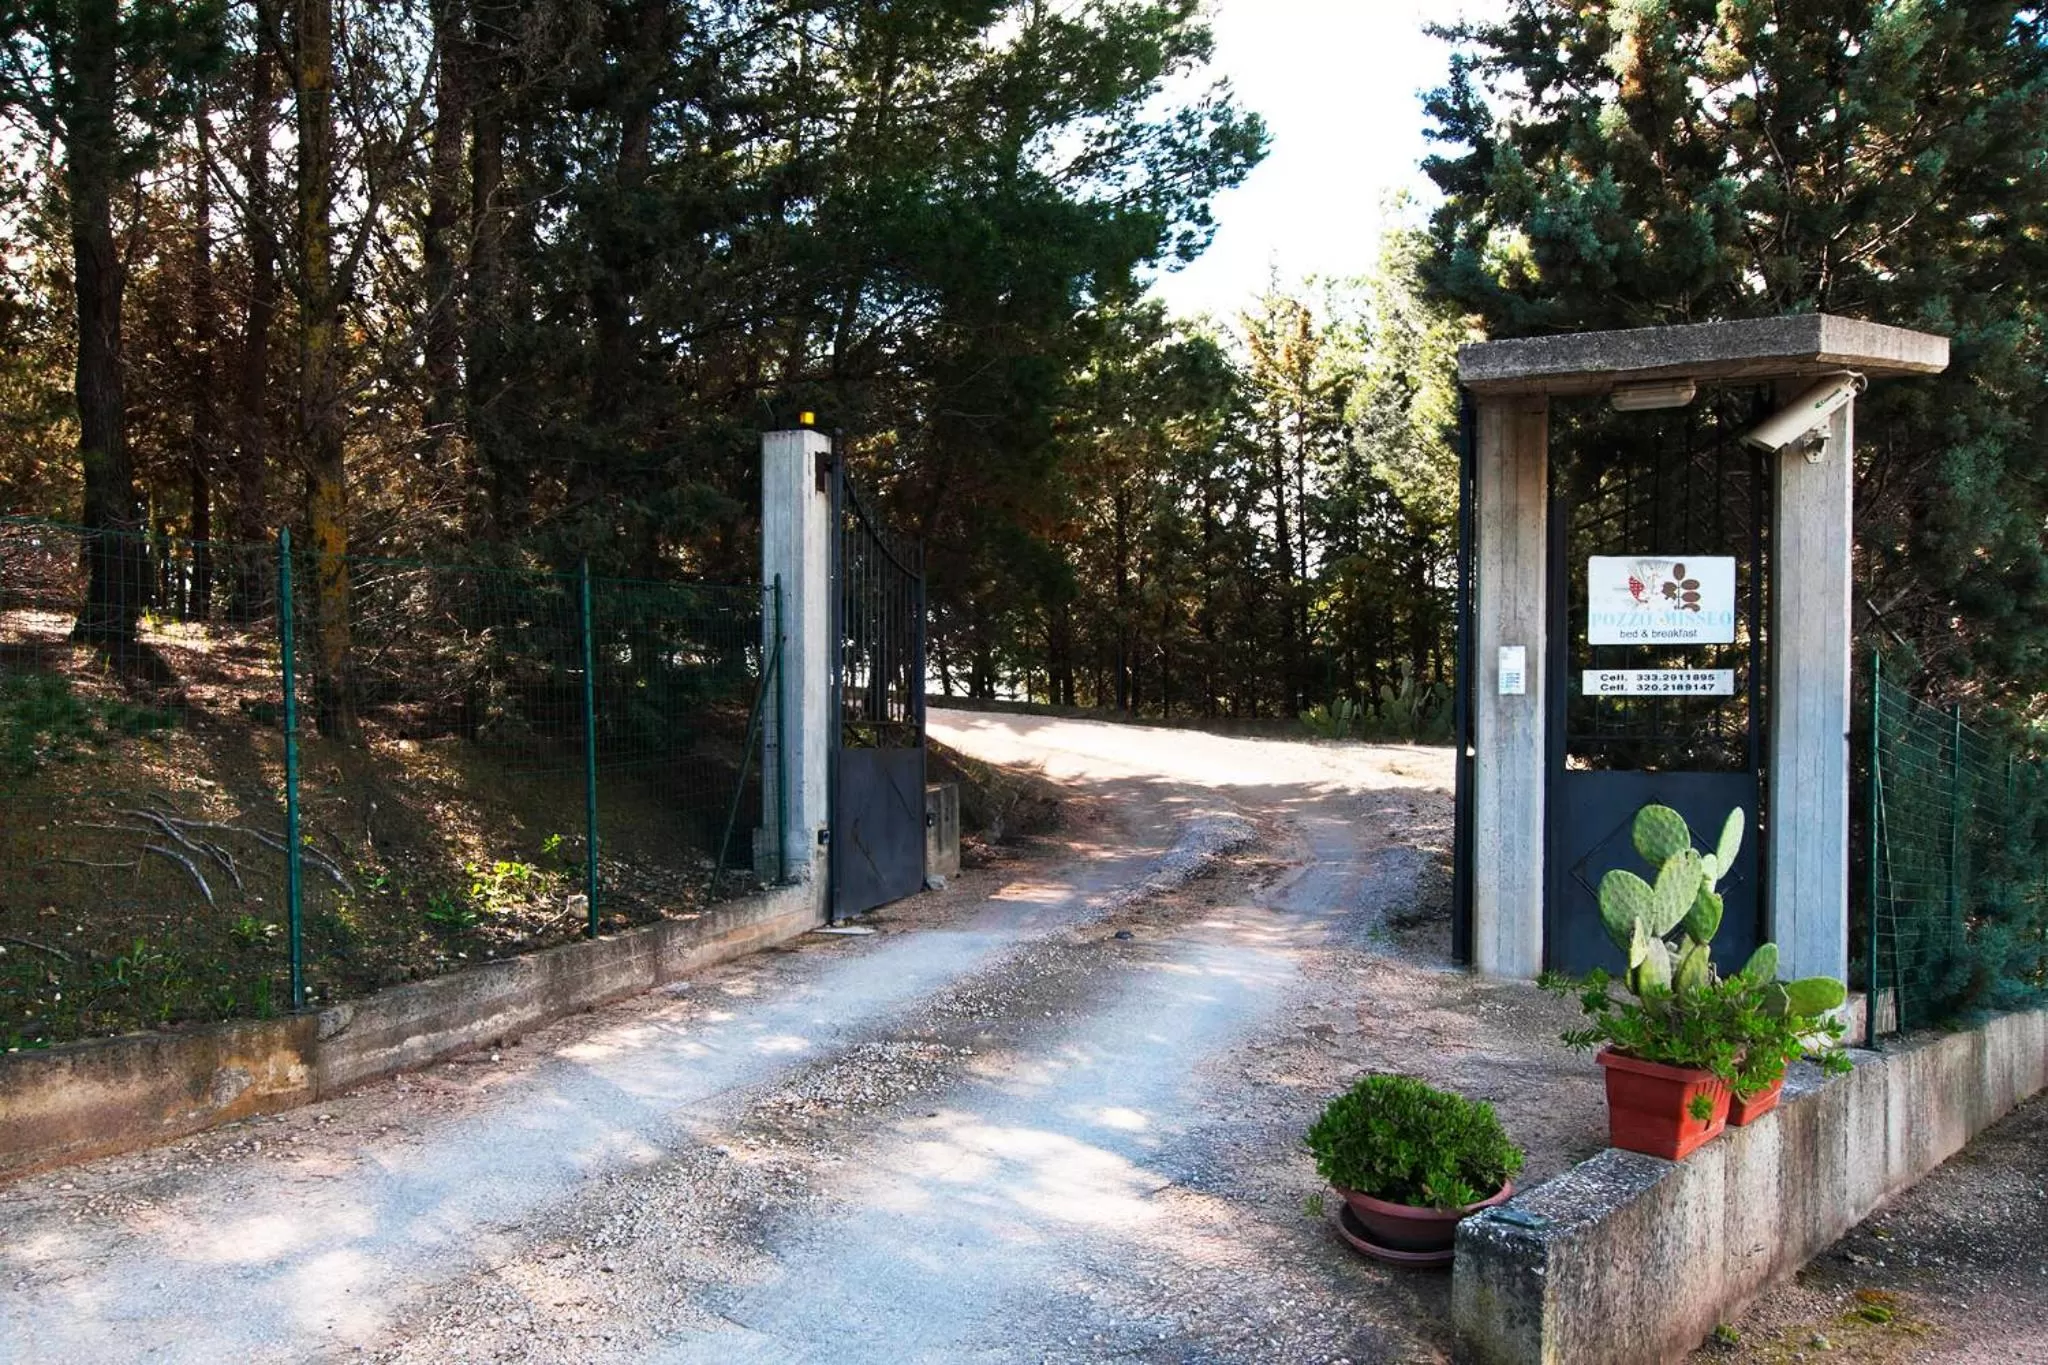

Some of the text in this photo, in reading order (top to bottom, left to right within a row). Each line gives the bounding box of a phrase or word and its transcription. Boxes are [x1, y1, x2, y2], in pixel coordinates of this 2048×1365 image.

[1619, 629, 1697, 638] bed & breakfast
[1600, 673, 1628, 682] Cell.
[1600, 683, 1628, 692] Cell.
